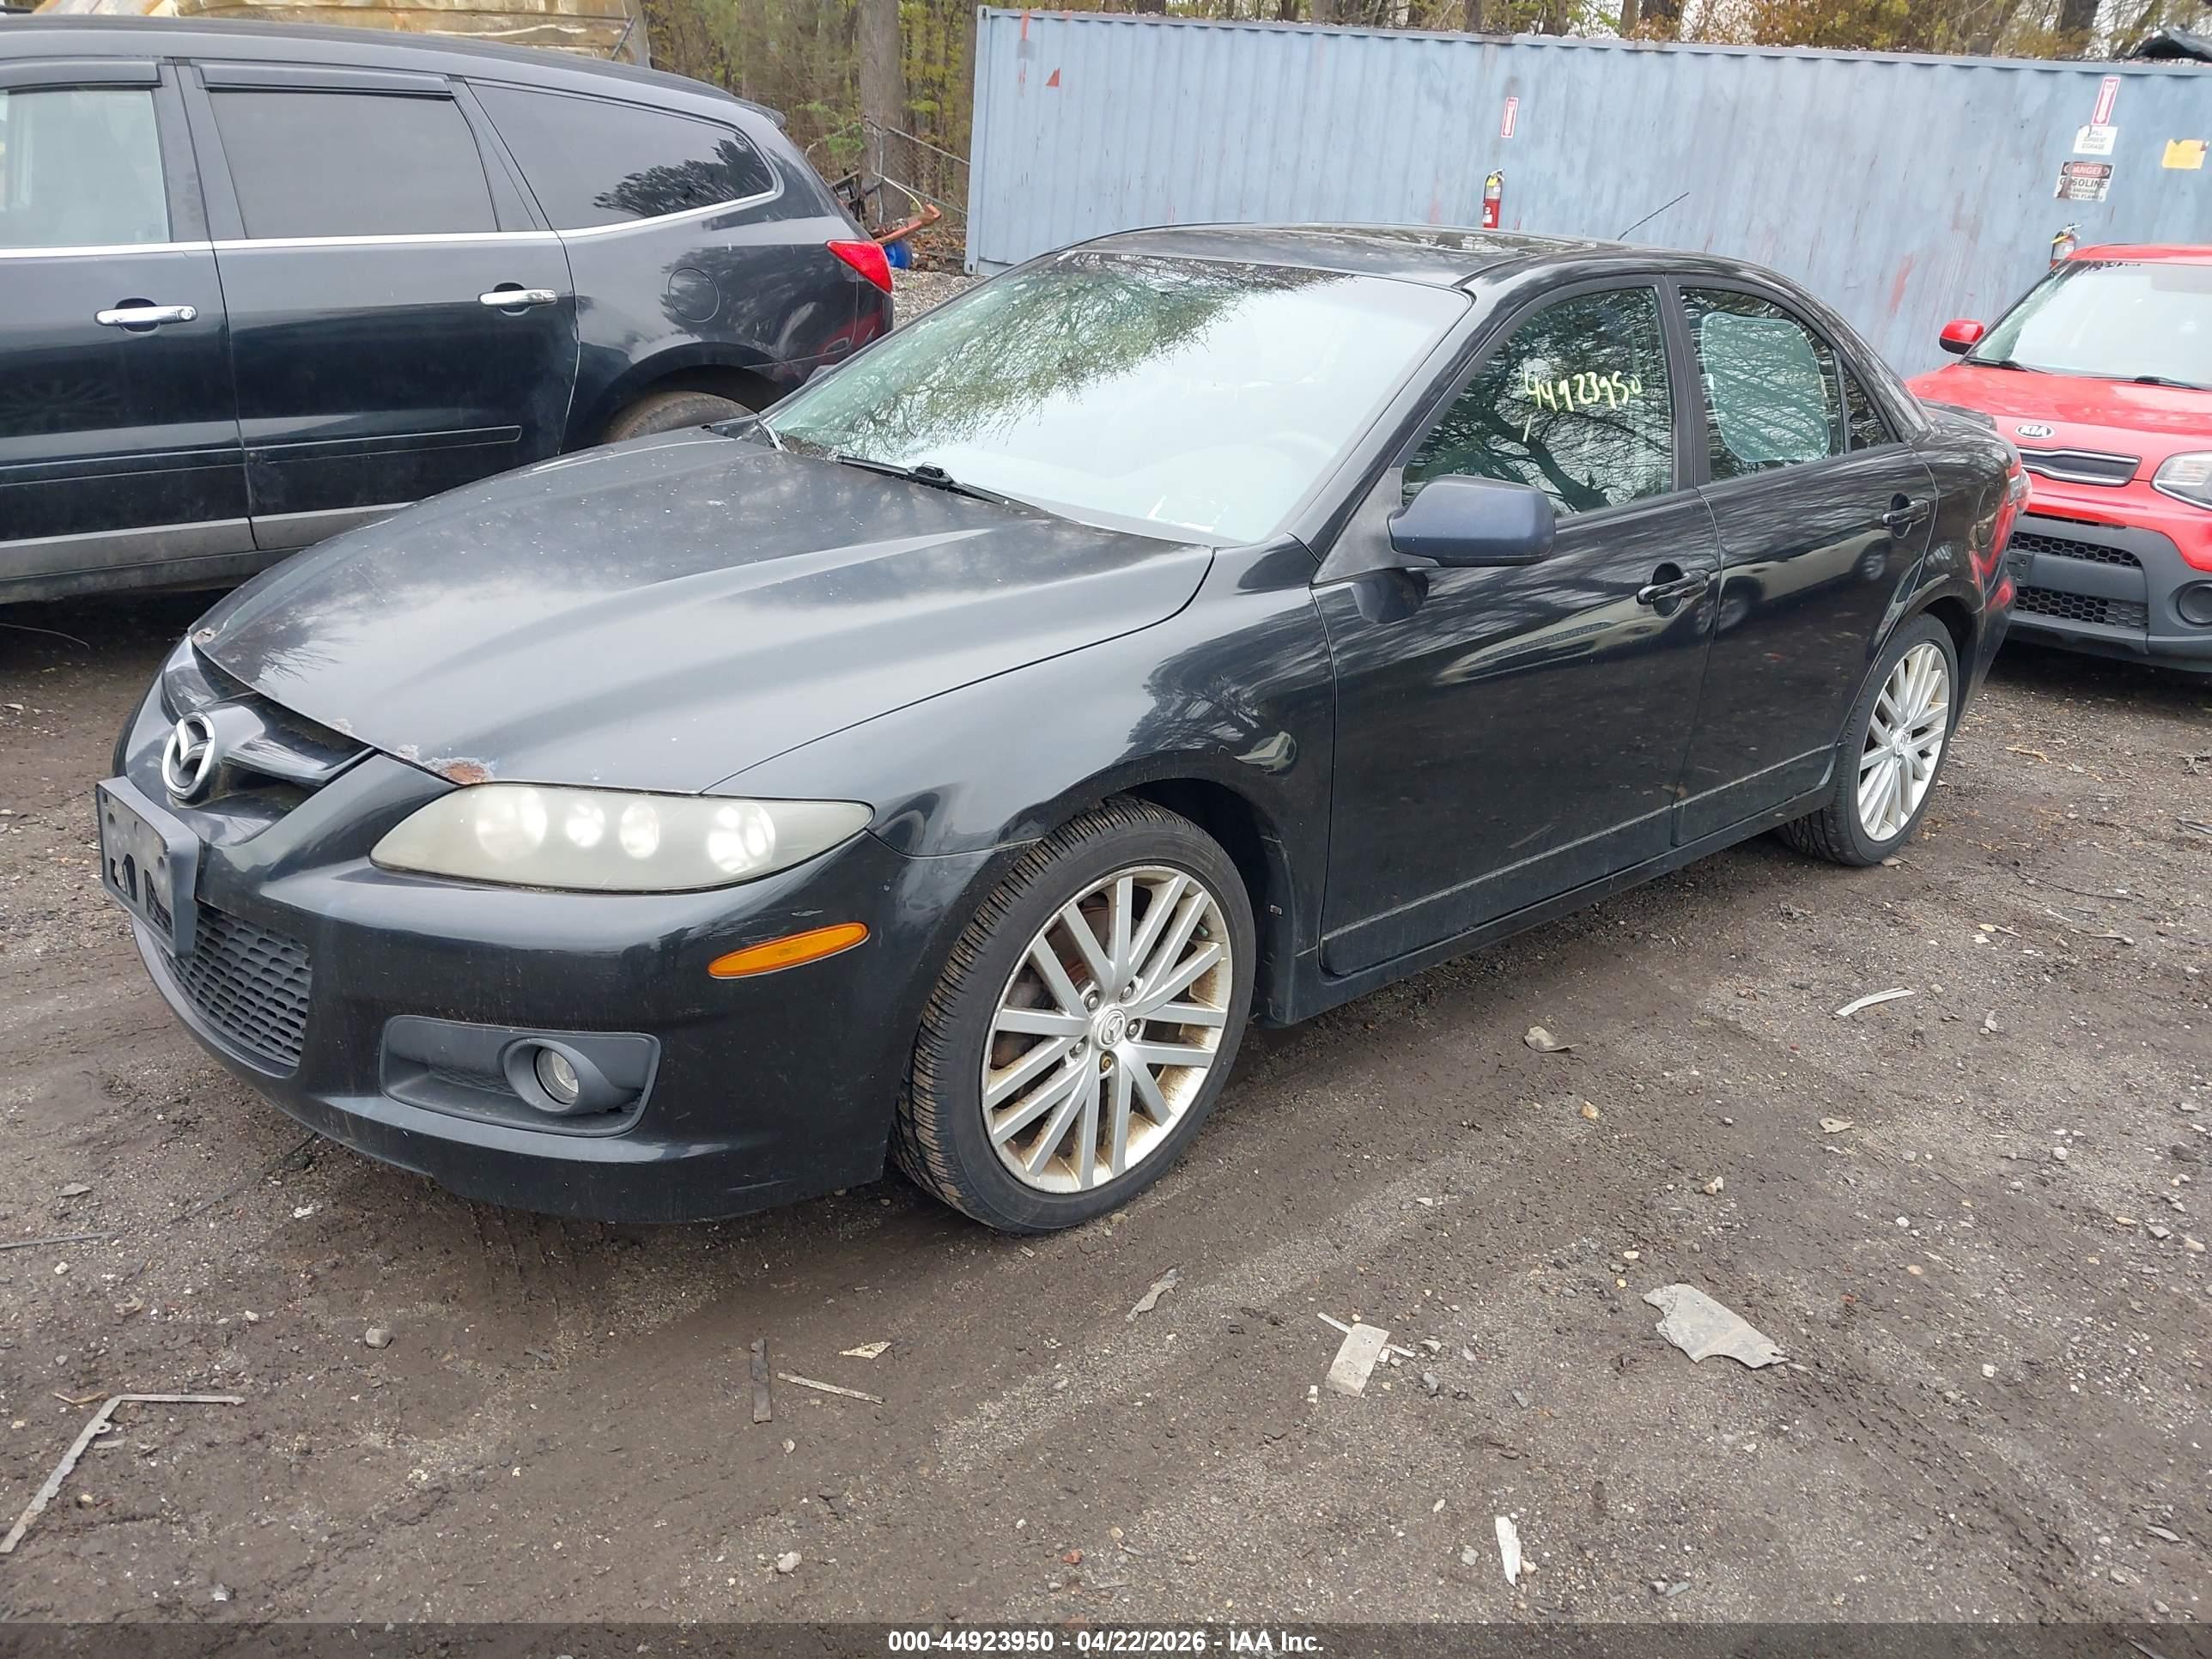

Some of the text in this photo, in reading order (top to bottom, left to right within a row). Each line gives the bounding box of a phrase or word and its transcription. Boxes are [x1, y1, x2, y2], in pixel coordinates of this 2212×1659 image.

[2060, 177, 2109, 188] GSOLINE
[1524, 370, 1642, 411] 44923950
[2020, 425, 2047, 436] KIA
